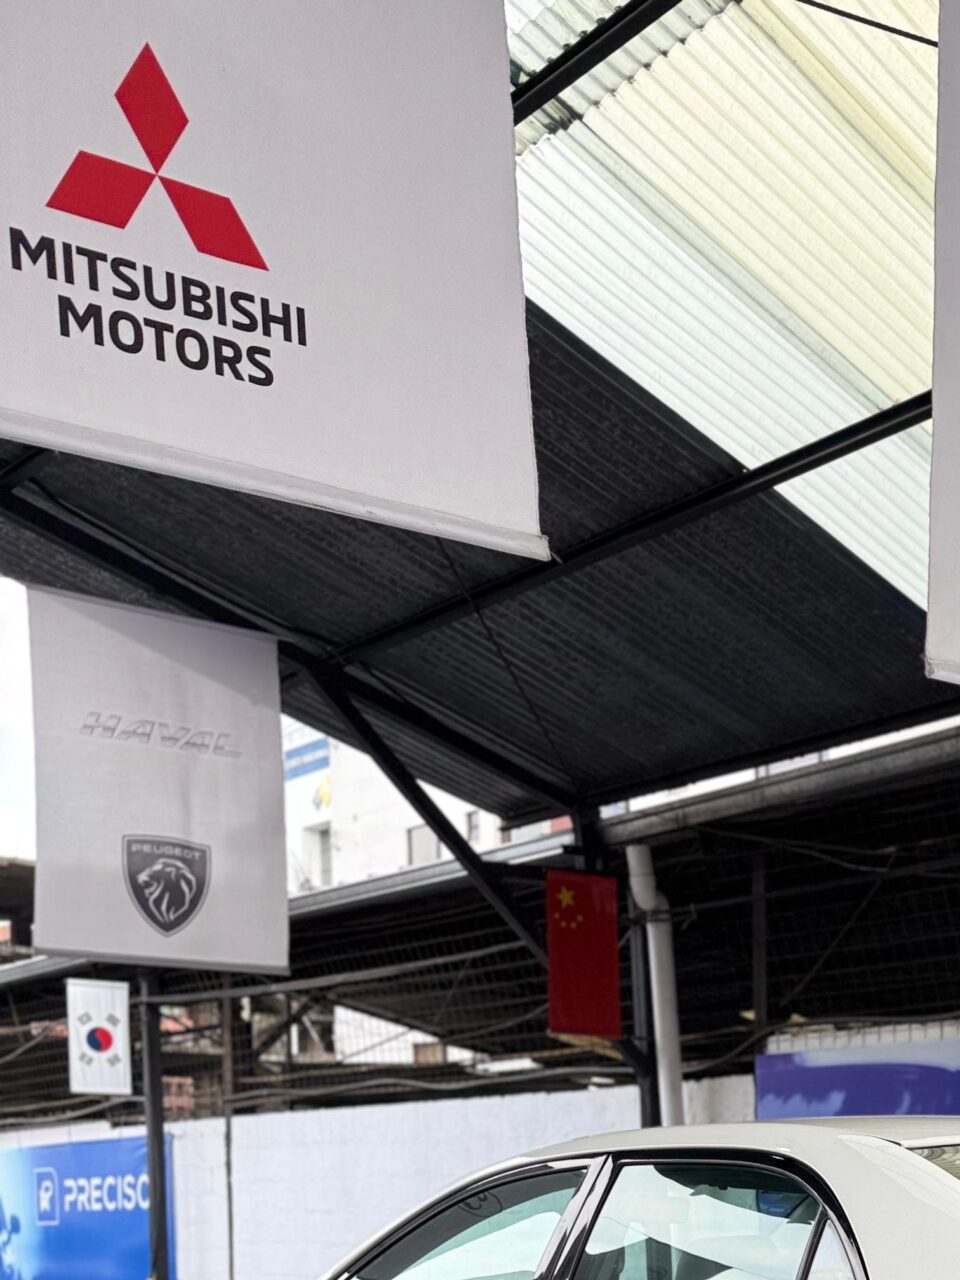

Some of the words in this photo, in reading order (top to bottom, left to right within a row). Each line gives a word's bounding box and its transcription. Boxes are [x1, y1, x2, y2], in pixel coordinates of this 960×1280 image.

[9, 226, 308, 347] MITSUBISHI
[57, 294, 274, 387] MOTORS
[80, 710, 243, 760] HAVAL
[131, 842, 203, 861] PEUGEOT
